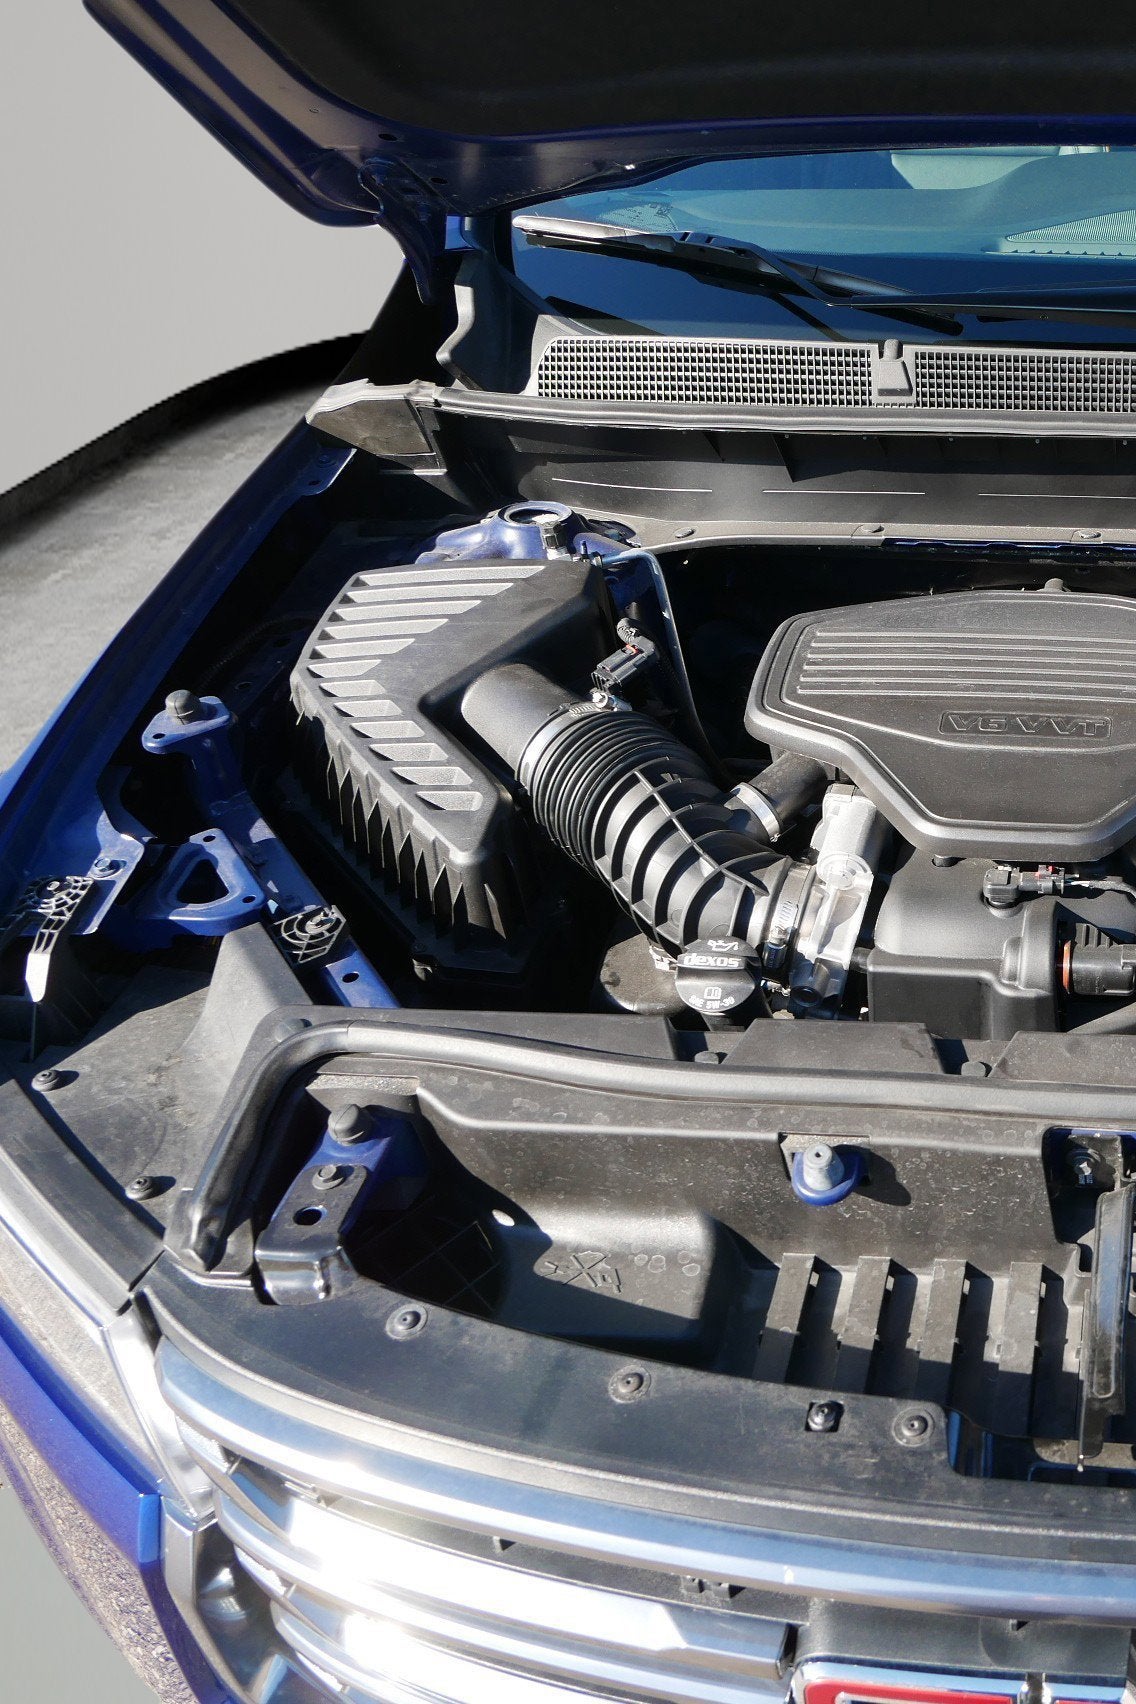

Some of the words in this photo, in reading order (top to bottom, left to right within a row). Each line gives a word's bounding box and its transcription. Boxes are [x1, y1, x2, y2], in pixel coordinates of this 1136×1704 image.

[948, 714, 1008, 733] V6
[1015, 716, 1107, 737] VVT
[683, 953, 742, 968] dexos
